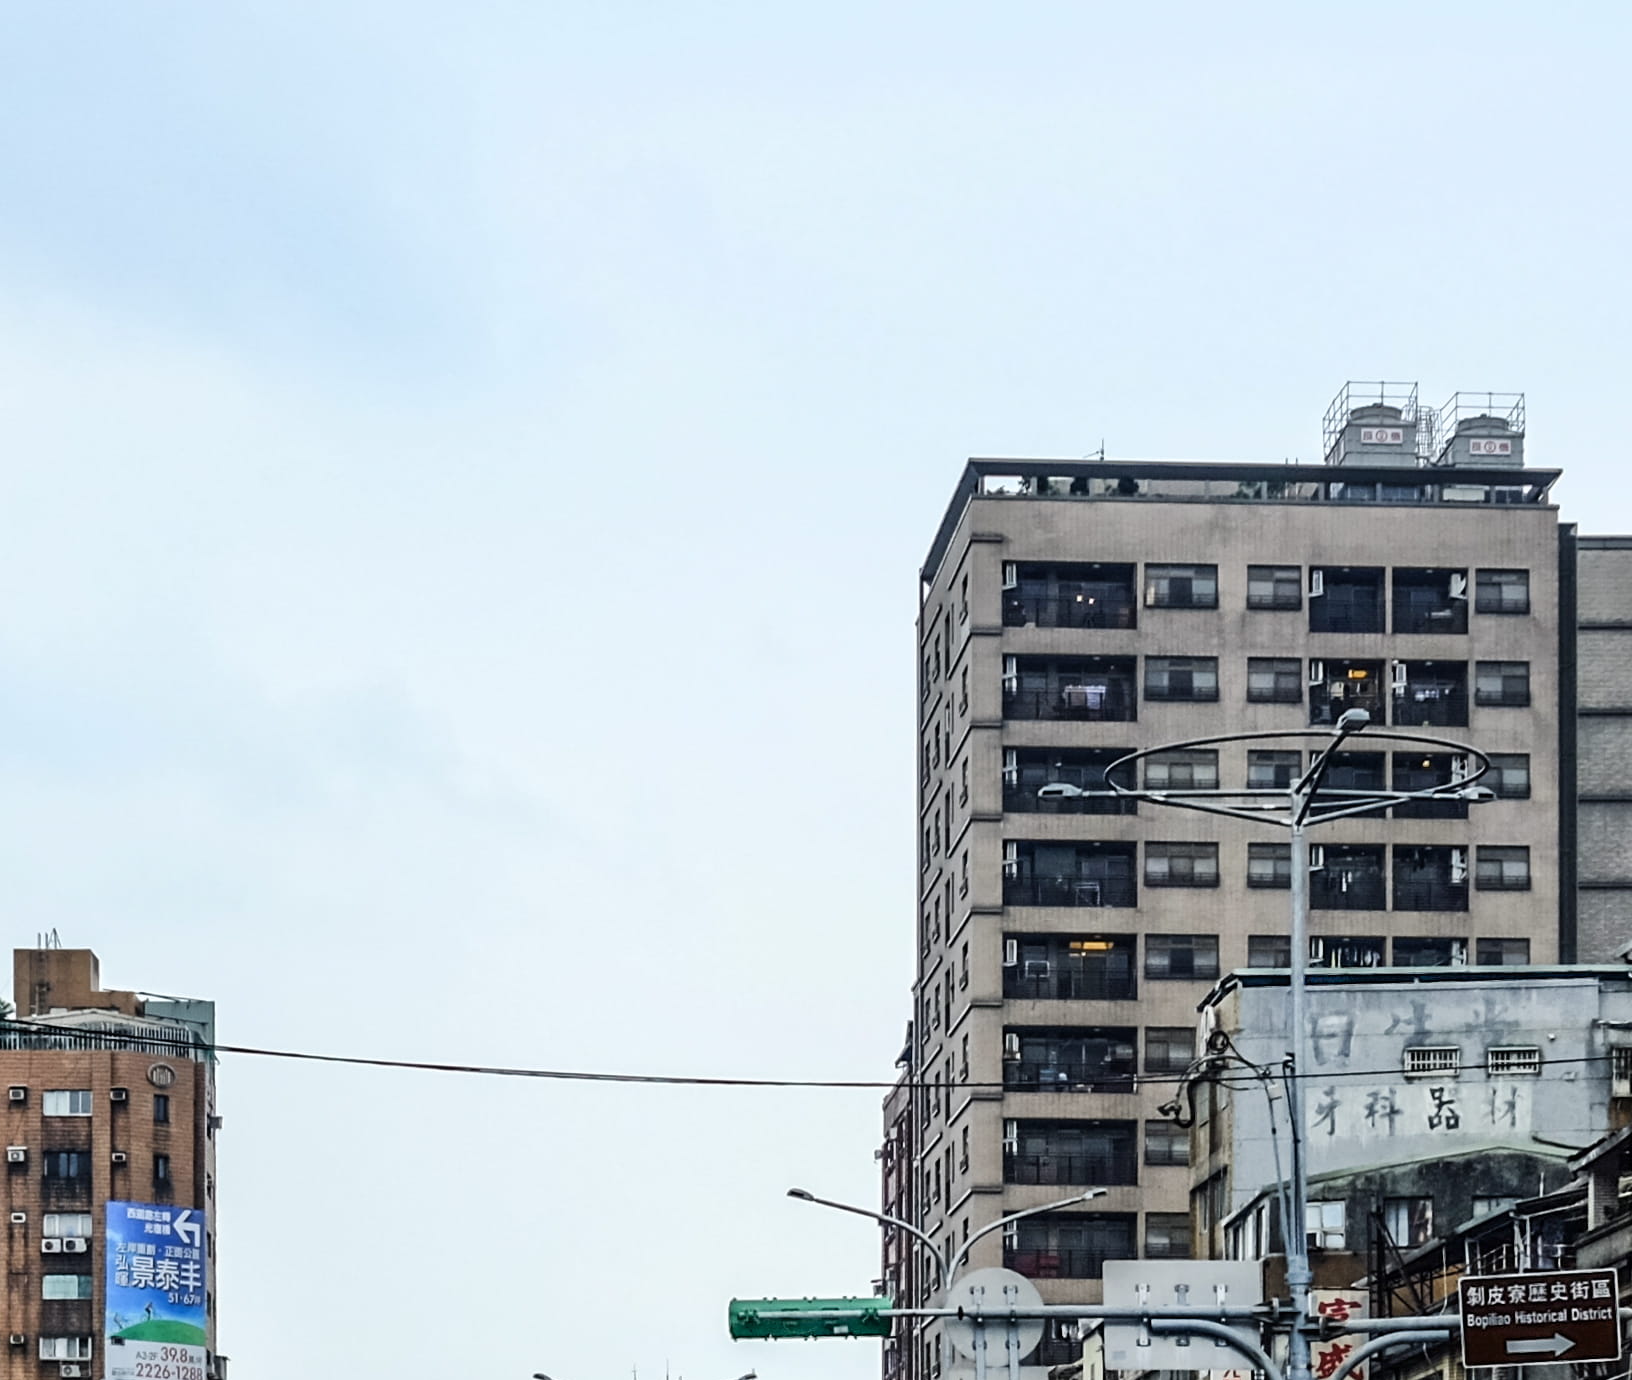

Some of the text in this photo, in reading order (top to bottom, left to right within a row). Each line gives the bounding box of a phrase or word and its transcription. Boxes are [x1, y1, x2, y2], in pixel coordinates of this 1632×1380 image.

[1311, 1085, 1522, 1136] 牙科器材
[1466, 1279, 1611, 1306] 剝皮寮歷史街區
[1515, 1308, 1567, 1324] Historical
[1571, 1306, 1612, 1321] District
